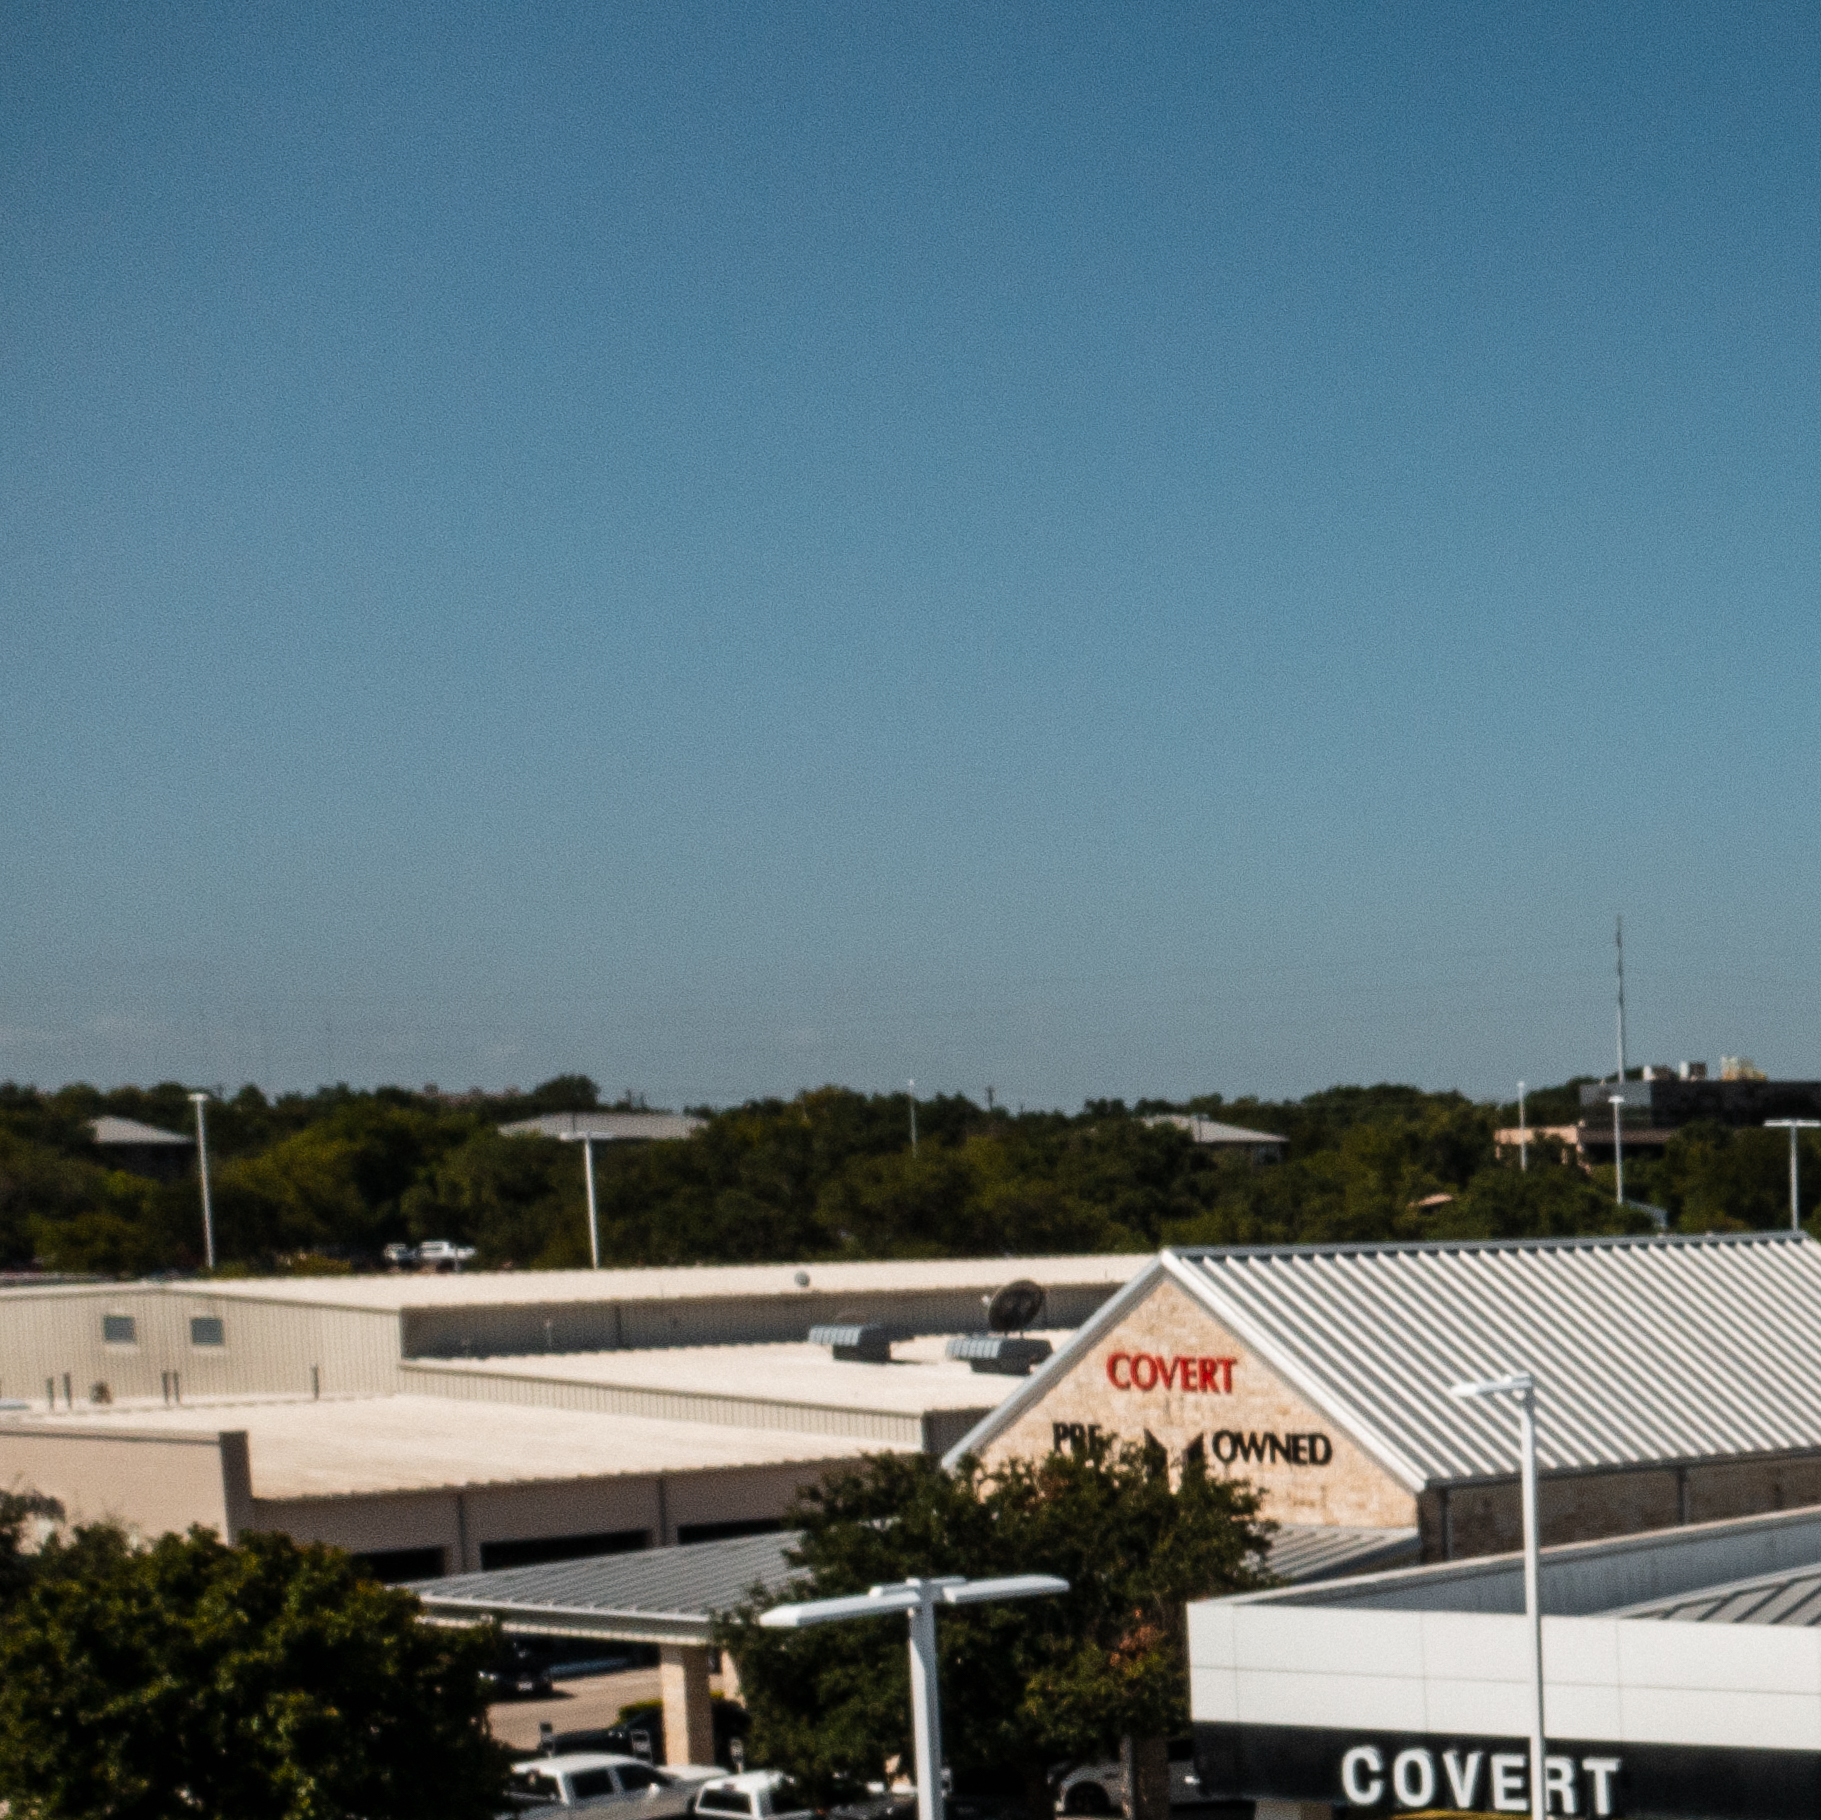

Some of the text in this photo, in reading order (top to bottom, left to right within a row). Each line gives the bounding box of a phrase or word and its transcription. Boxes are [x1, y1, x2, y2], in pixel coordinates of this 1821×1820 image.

[1106, 1352, 1237, 1394] COVERT
[1212, 1429, 1333, 1465] OWNED
[1341, 1744, 1621, 1816] COVERT
